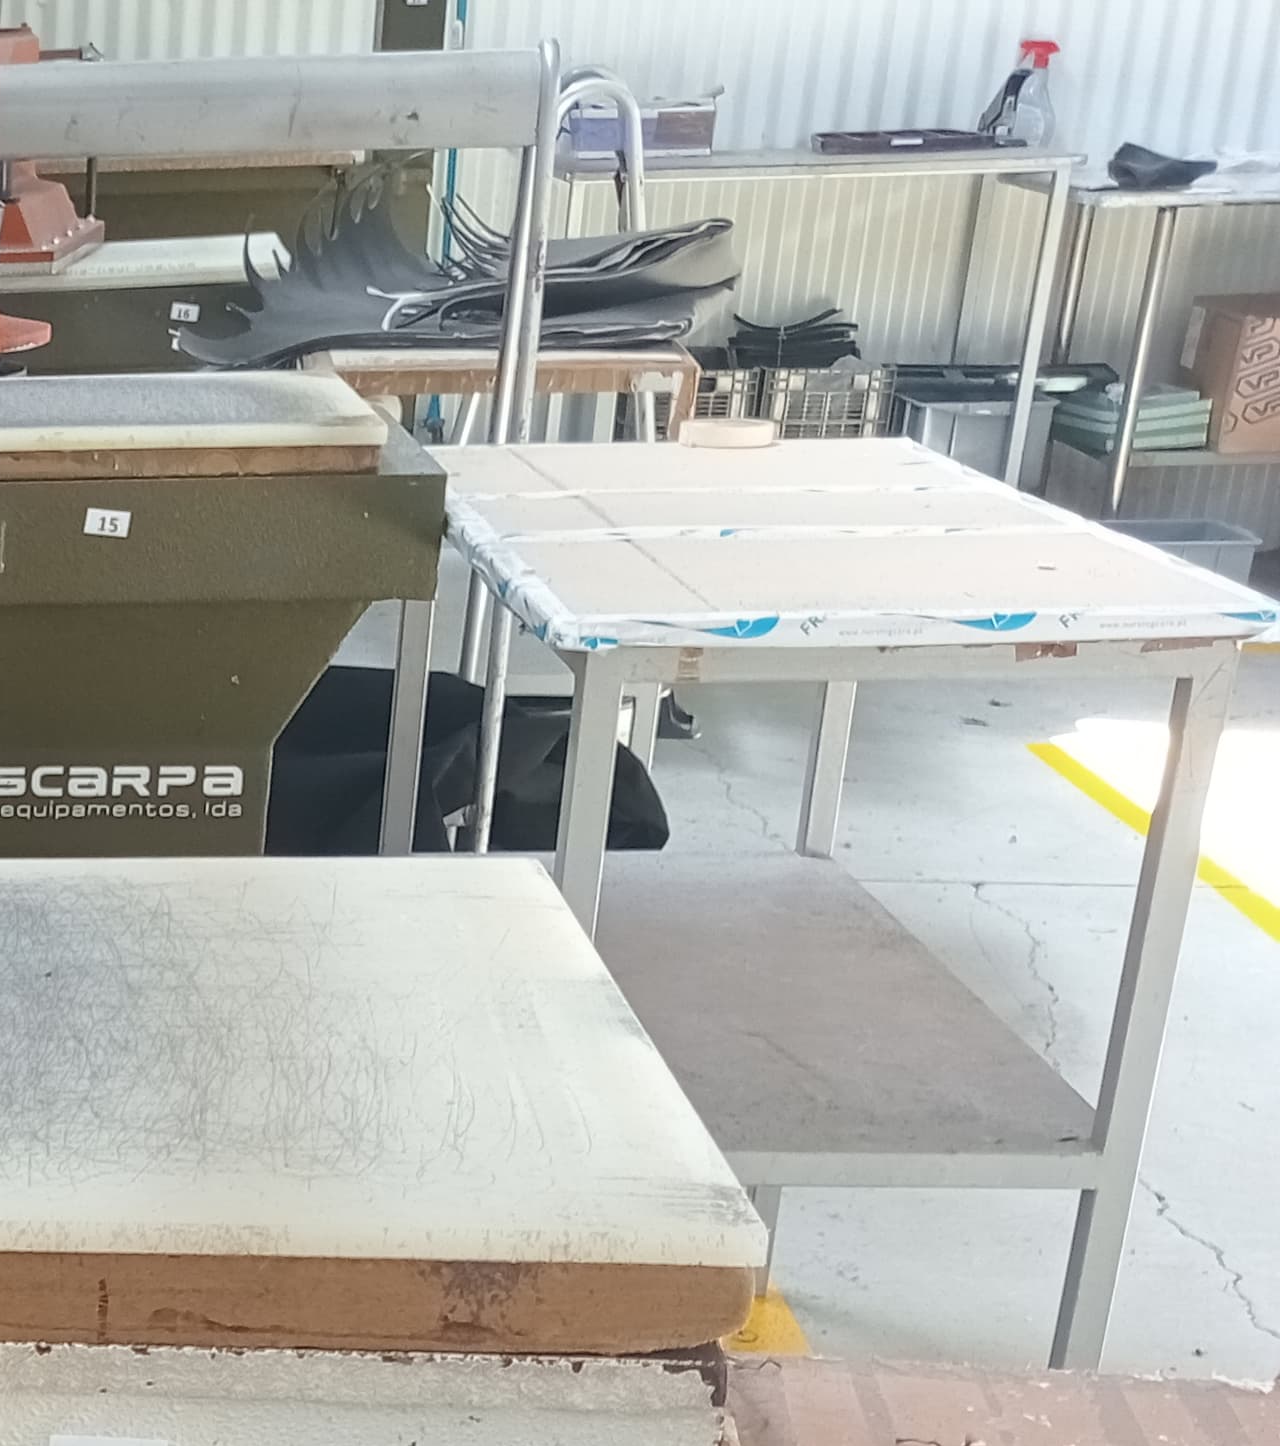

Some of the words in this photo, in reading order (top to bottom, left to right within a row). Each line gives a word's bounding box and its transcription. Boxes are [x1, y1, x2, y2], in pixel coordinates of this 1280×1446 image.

[176, 307, 190, 320] 16
[97, 516, 120, 534] 15
[0, 801, 197, 821] equipamentos,
[204, 802, 243, 818] lda
